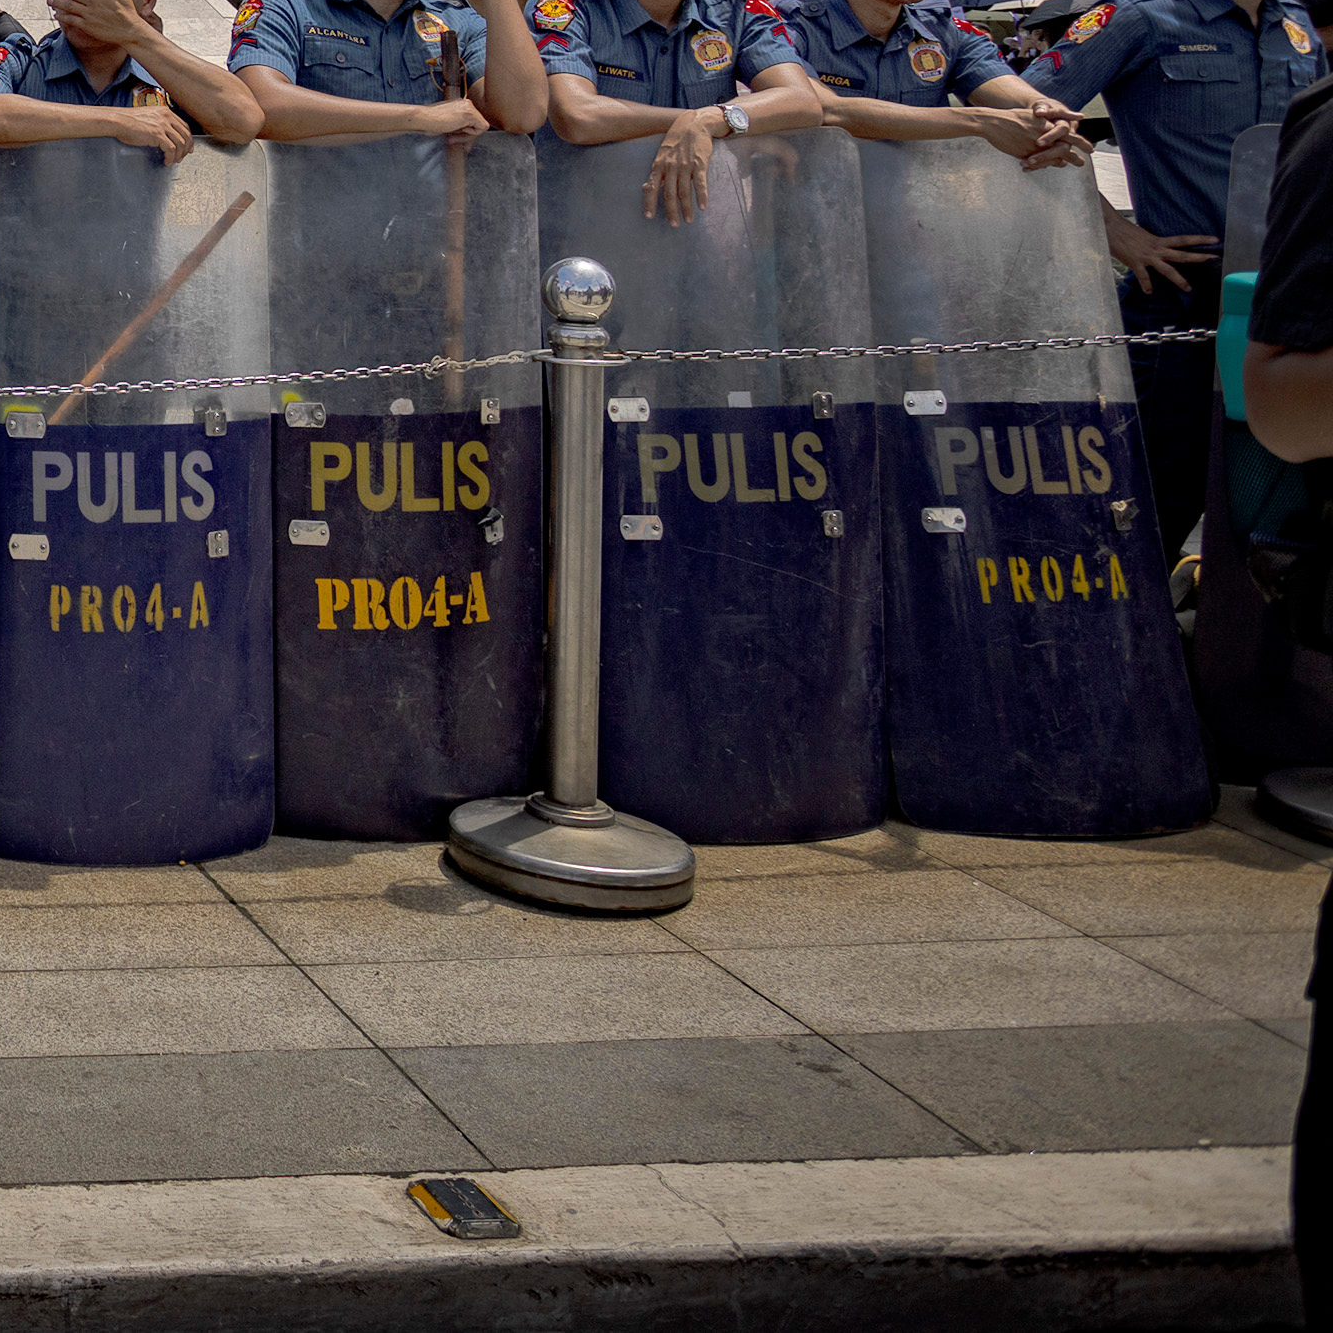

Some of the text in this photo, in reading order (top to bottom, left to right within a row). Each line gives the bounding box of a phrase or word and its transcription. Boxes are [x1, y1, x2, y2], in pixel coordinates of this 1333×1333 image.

[308, 26, 366, 45] ALCANTARA
[1178, 44, 1217, 52] SIMEON
[598, 65, 637, 80] LIWATIC
[32, 450, 215, 524] PULIS
[310, 440, 491, 512] PULIS
[639, 431, 828, 504] PULIS
[935, 425, 1113, 496] PULIS
[49, 581, 210, 633] PRO4-A
[316, 571, 491, 632] PRO4-A
[976, 555, 1130, 604] PRO4-A
